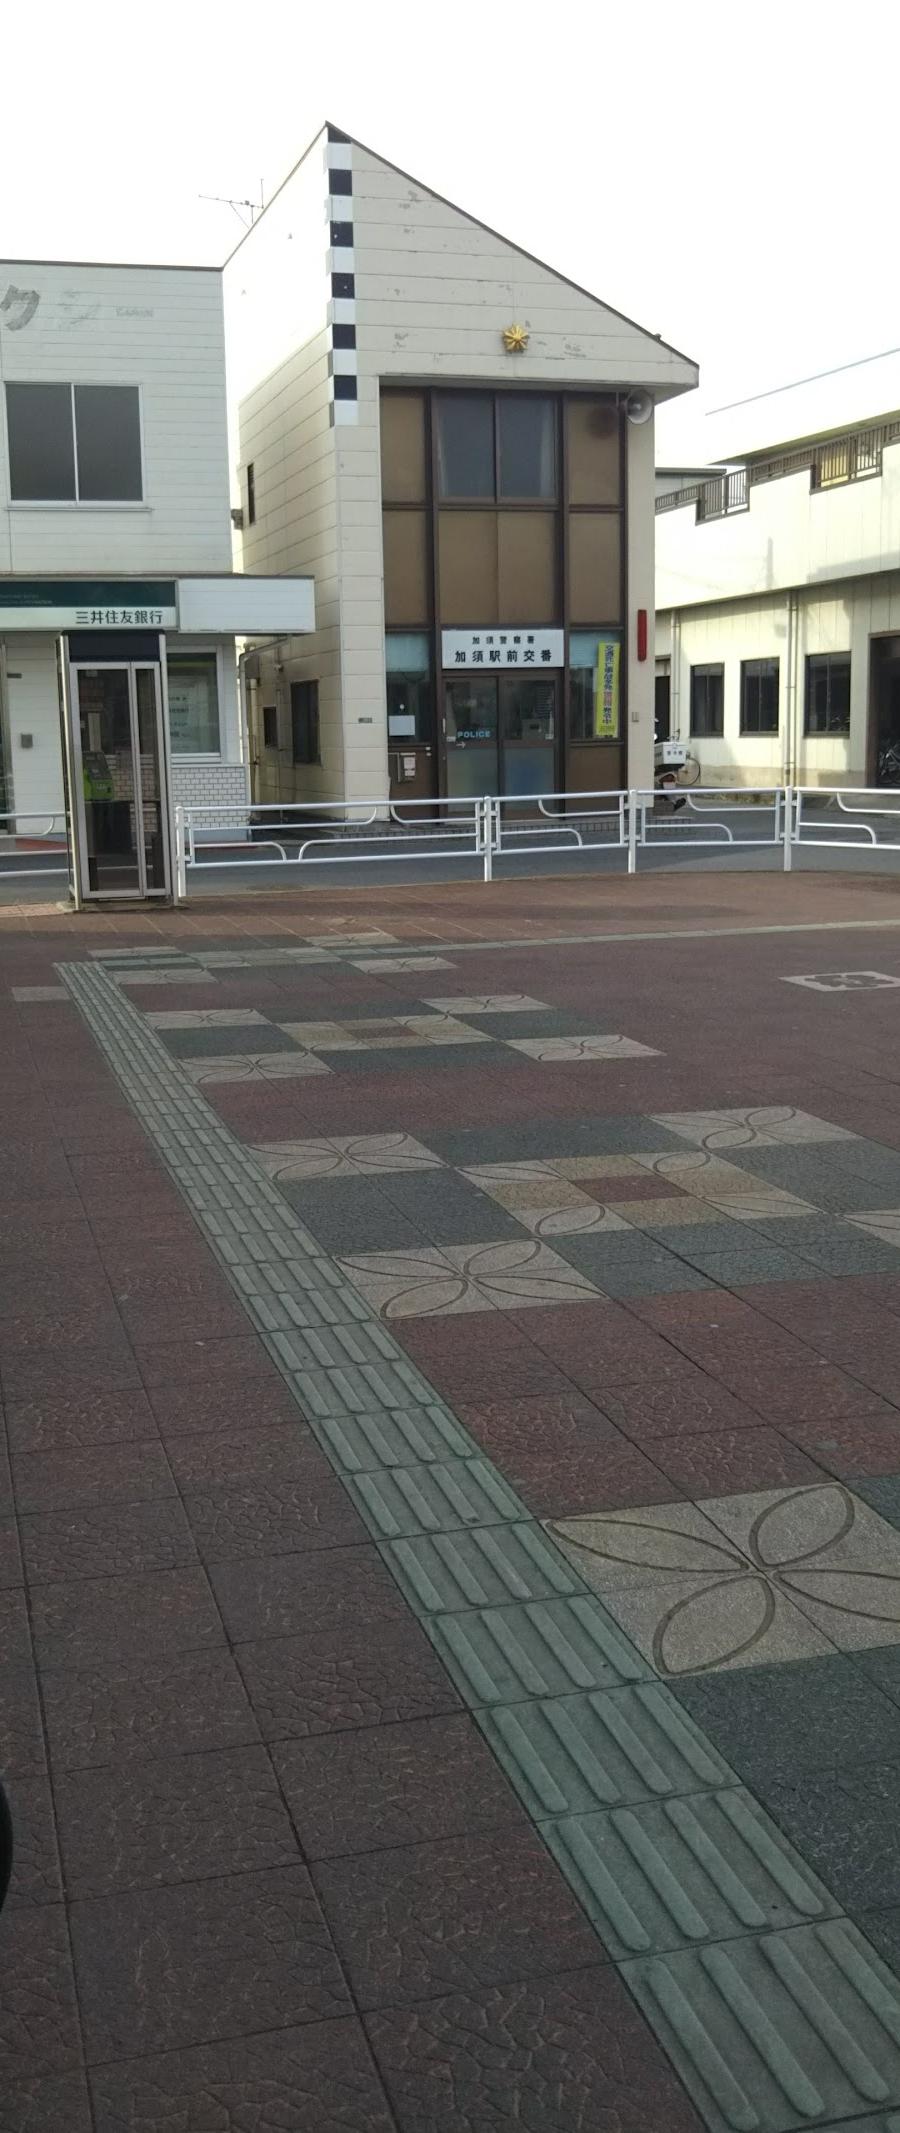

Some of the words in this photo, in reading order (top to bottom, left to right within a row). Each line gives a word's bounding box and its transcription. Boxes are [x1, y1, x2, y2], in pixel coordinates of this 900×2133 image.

[75, 610, 163, 625] 三井住友銀行
[471, 635, 535, 645] 加須警察署
[454, 649, 552, 663] 加須駅前交番
[456, 730, 491, 739] POLICE
